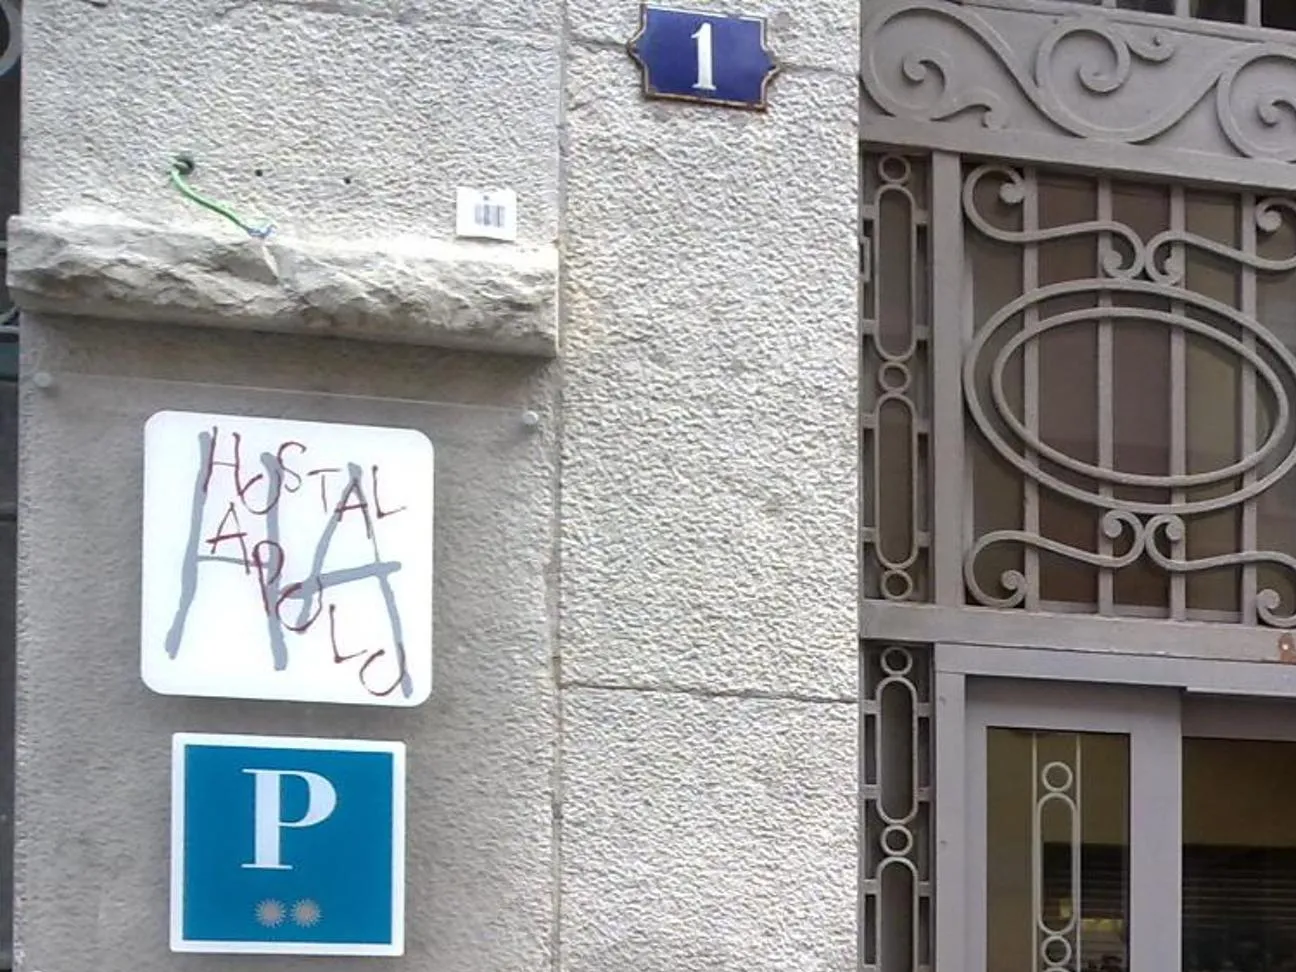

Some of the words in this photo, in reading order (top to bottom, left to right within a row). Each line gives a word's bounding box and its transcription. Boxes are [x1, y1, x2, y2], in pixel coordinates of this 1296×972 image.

[691, 22, 717, 91] 1
[203, 426, 407, 541] HOSTAL
[205, 502, 407, 697] APOLO
[241, 768, 337, 870] P
